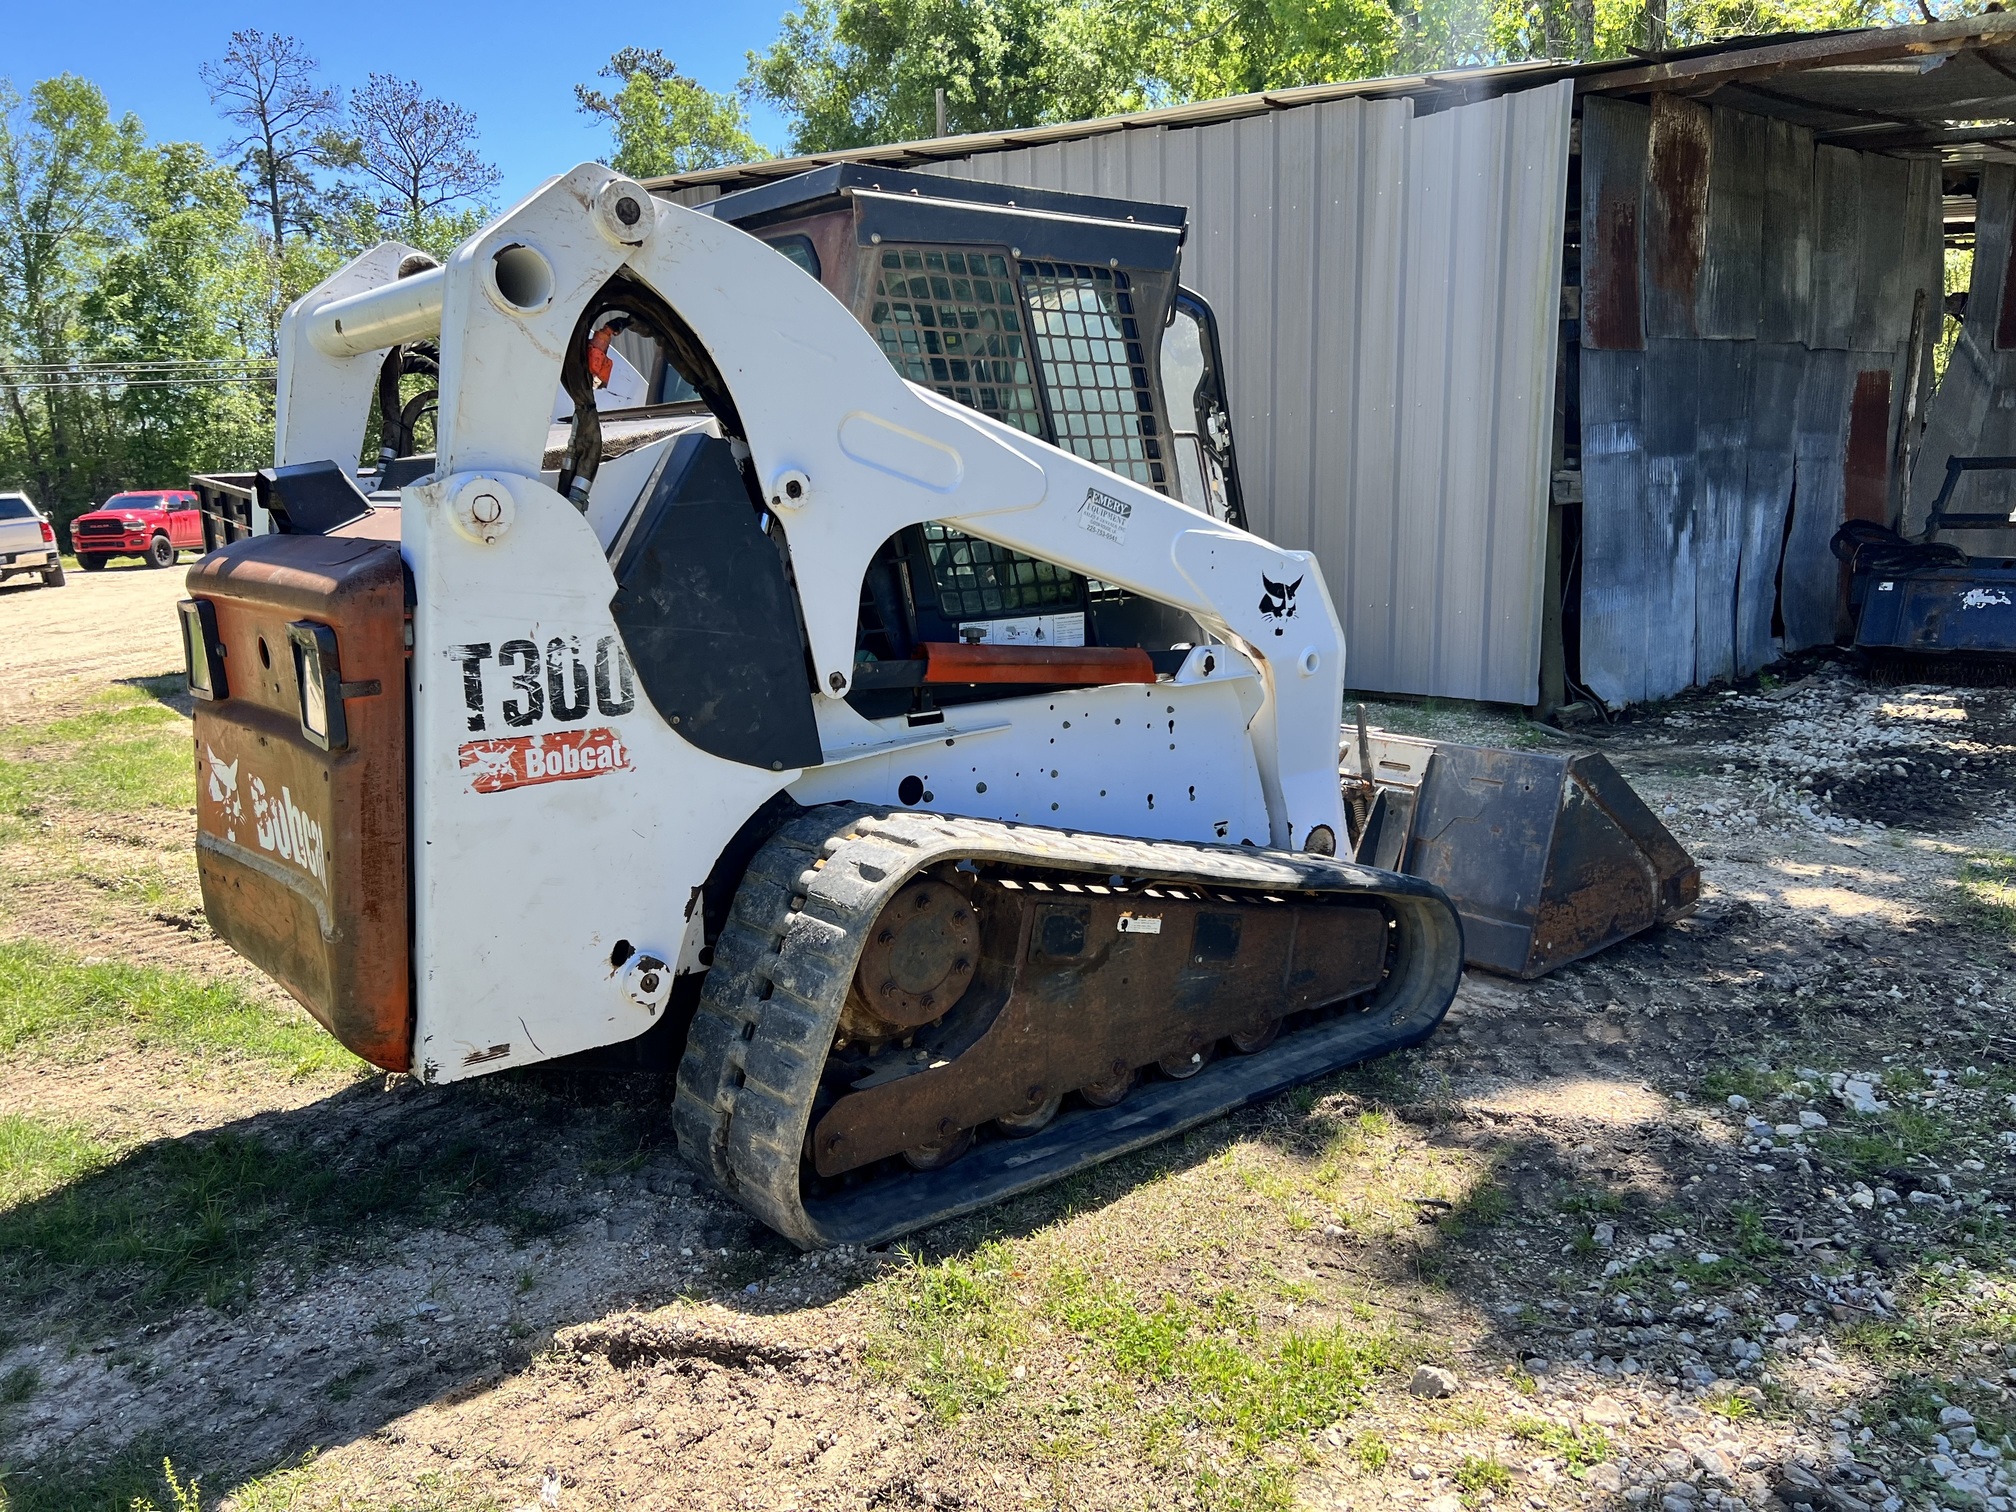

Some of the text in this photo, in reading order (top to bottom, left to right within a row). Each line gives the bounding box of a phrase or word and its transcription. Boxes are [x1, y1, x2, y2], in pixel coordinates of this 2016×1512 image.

[1092, 490, 1128, 514] EMERY
[447, 635, 635, 732] T300
[525, 740, 624, 778] Bobcat
